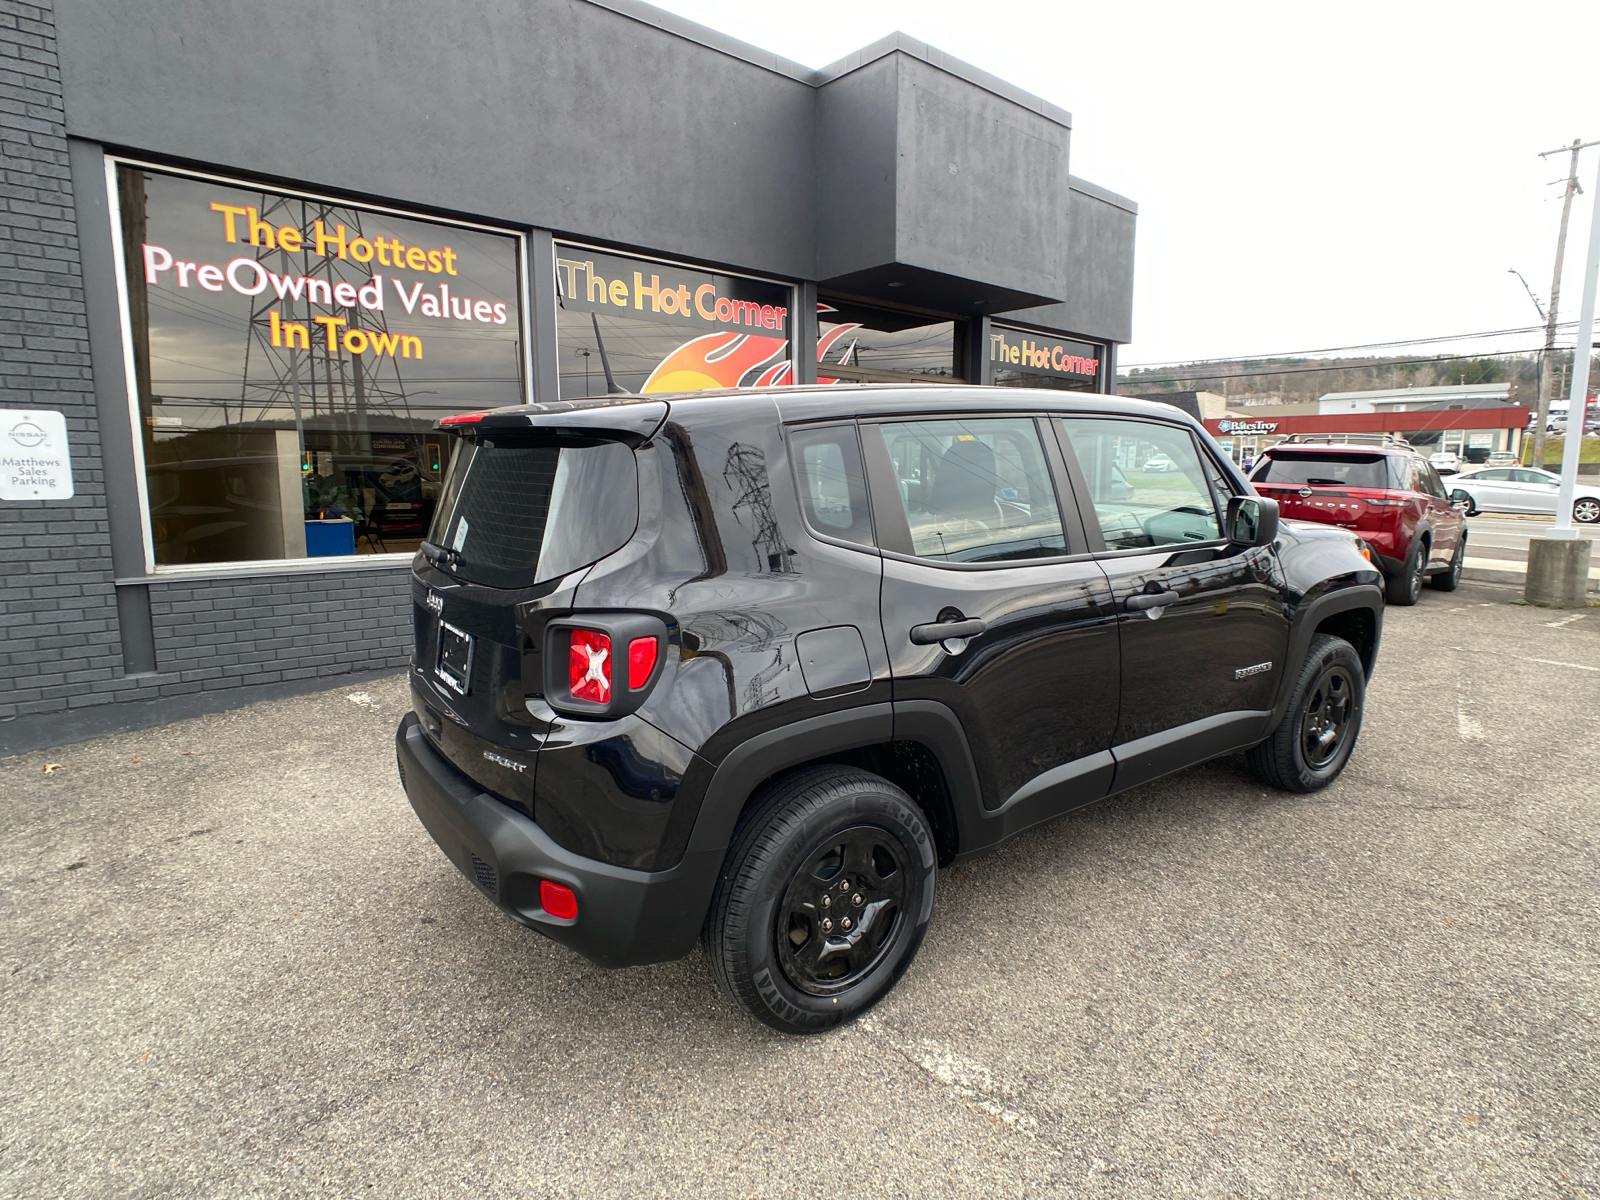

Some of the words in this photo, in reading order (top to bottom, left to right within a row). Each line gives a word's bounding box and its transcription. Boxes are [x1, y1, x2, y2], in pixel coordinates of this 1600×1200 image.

[209, 201, 303, 253] The
[313, 219, 457, 276] Hottest
[142, 243, 384, 311] PreOwned
[391, 277, 507, 325] Values
[557, 257, 628, 307] The
[633, 271, 691, 317] Hot
[694, 283, 787, 330] Corner
[269, 309, 310, 350] In
[314, 314, 423, 360] Town
[989, 334, 1020, 364] The
[1021, 339, 1050, 369] Hot
[1051, 345, 1098, 376] Corner
[2, 457, 60, 467] Matthews
[18, 467, 47, 476] Sales
[11, 476, 56, 488] Parking
[426, 589, 444, 617] Jeep
[483, 750, 527, 773] SPORT
